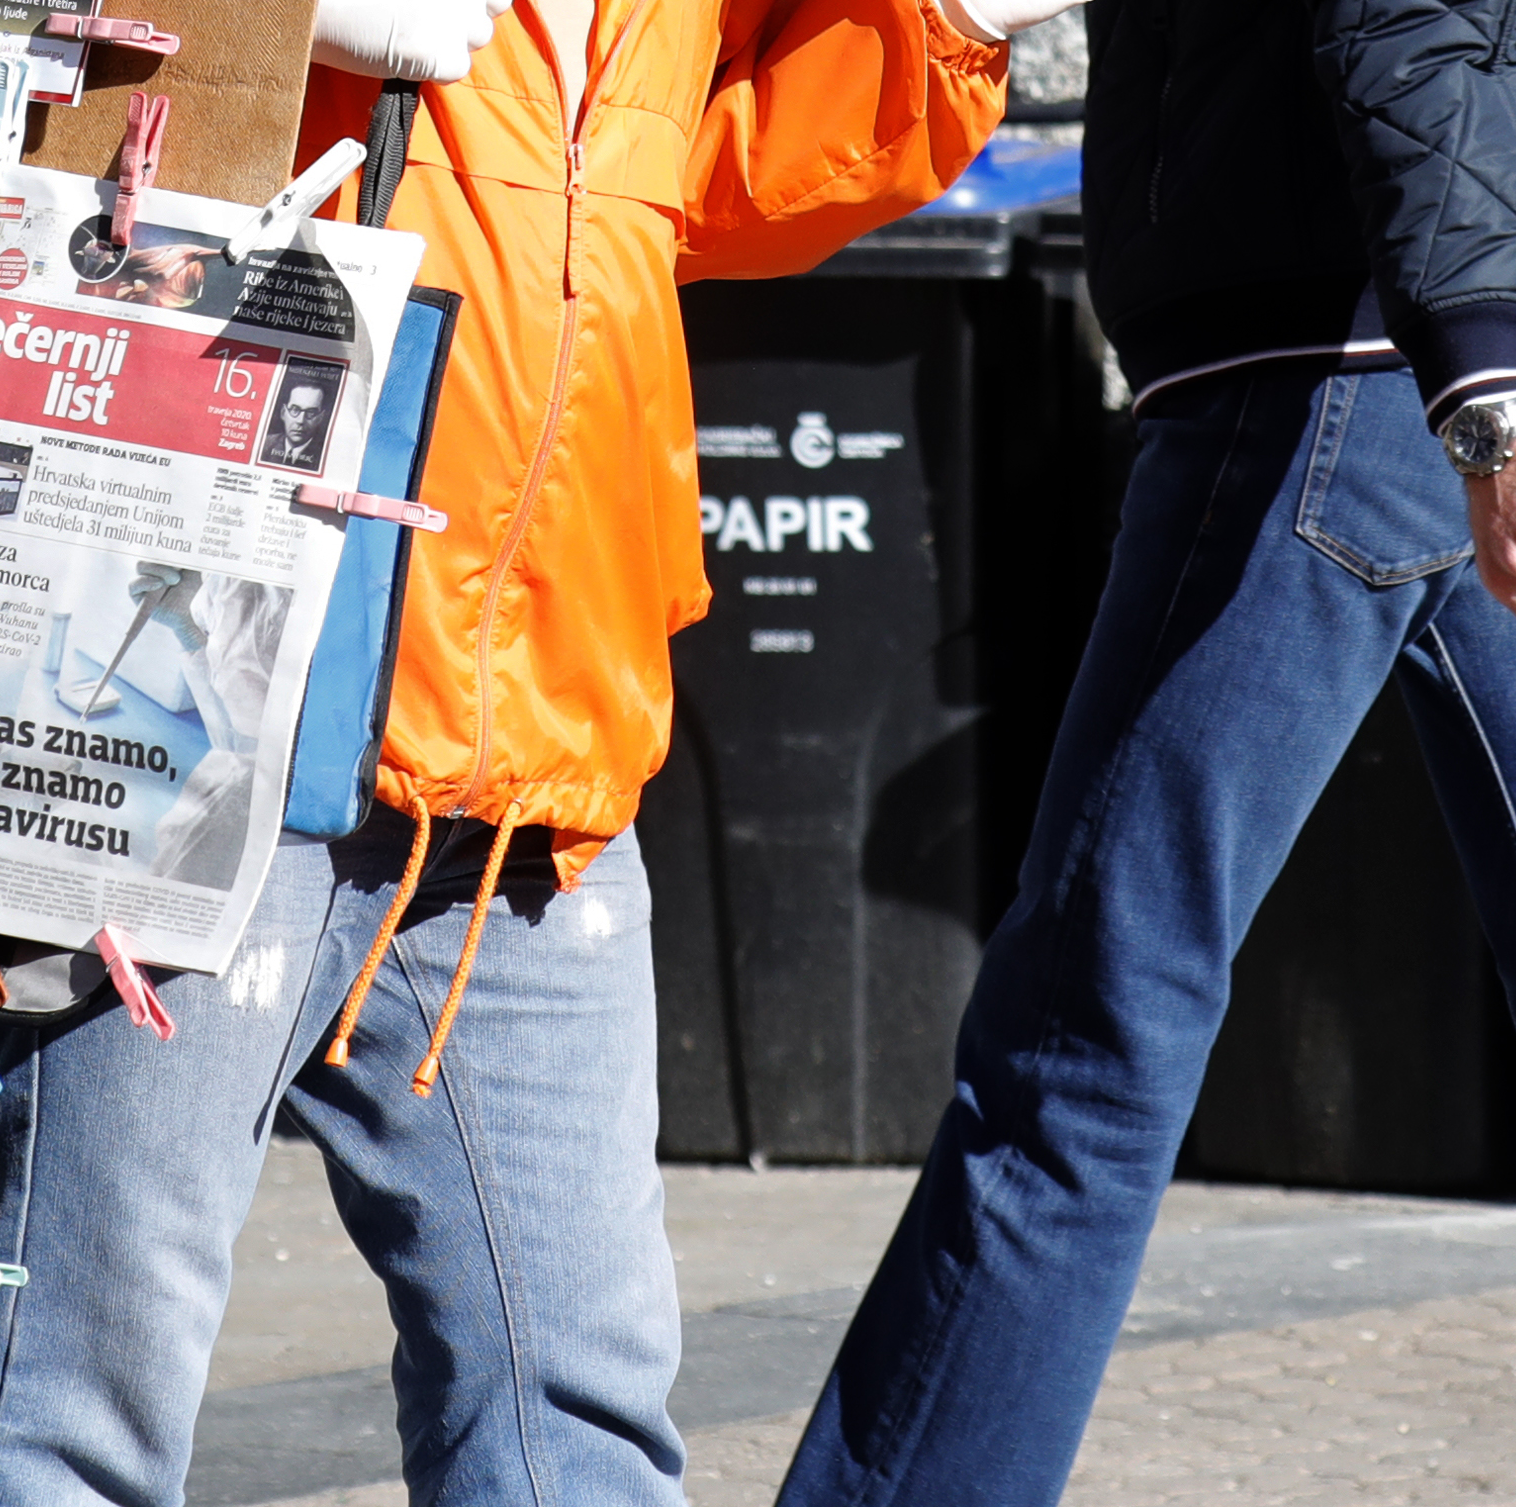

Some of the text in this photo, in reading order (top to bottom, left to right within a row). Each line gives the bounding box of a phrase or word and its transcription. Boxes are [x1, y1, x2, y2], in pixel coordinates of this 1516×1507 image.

[214, 347, 259, 400] 16.
[42, 371, 115, 426] list
[208, 406, 232, 417] travnja
[40, 436, 171, 467] NOVE METODE RADA VIJEĆA EU
[218, 439, 245, 450] Zagreb
[231, 430, 248, 441] kuna
[33, 465, 172, 505] Hrvatska virtualnim
[23, 509, 191, 553] uštedjela 31 milijun kuna
[27, 490, 184, 530] predsjedanjem Unijom
[700, 494, 873, 552] PAPIR
[43, 724, 177, 782] znamo,
[2, 762, 125, 809] znamo
